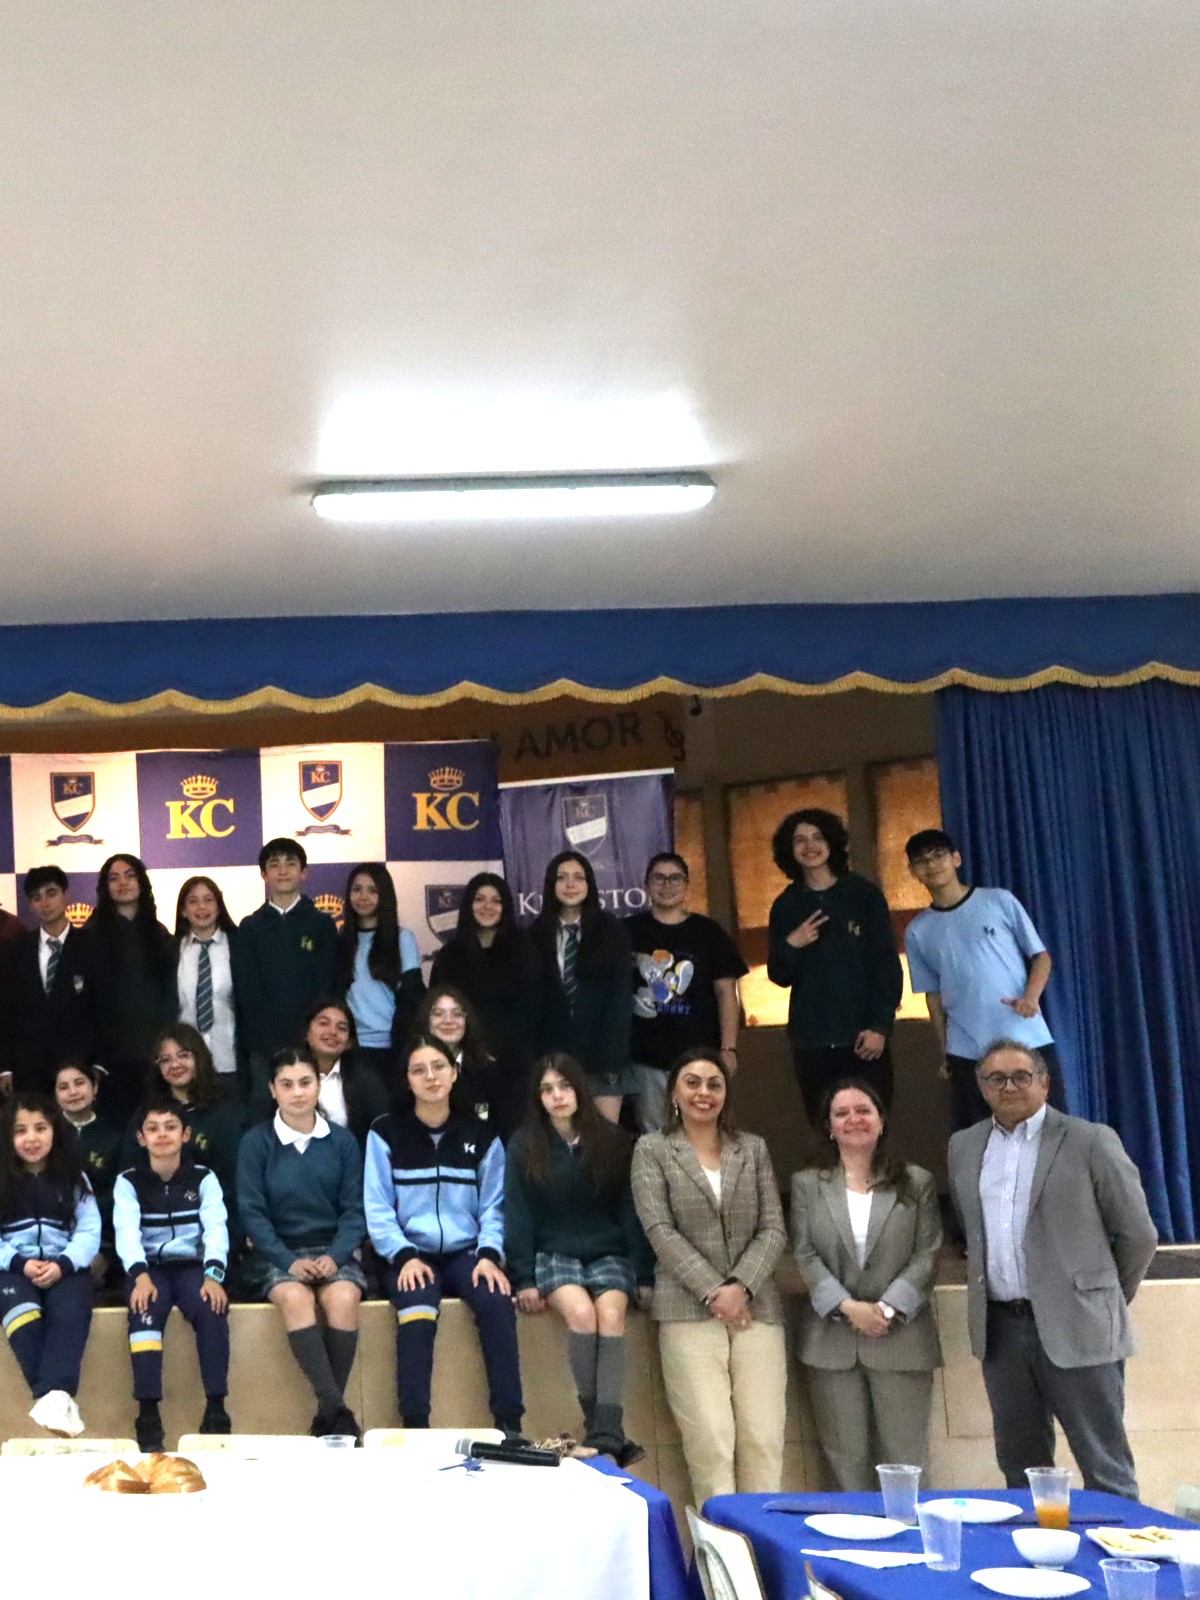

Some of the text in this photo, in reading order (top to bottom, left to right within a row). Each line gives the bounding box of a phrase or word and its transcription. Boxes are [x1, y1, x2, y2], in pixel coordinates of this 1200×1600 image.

[512, 710, 644, 761] AMOR
[311, 771, 330, 783] KC
[166, 796, 236, 838] KC
[411, 792, 480, 832] KC
